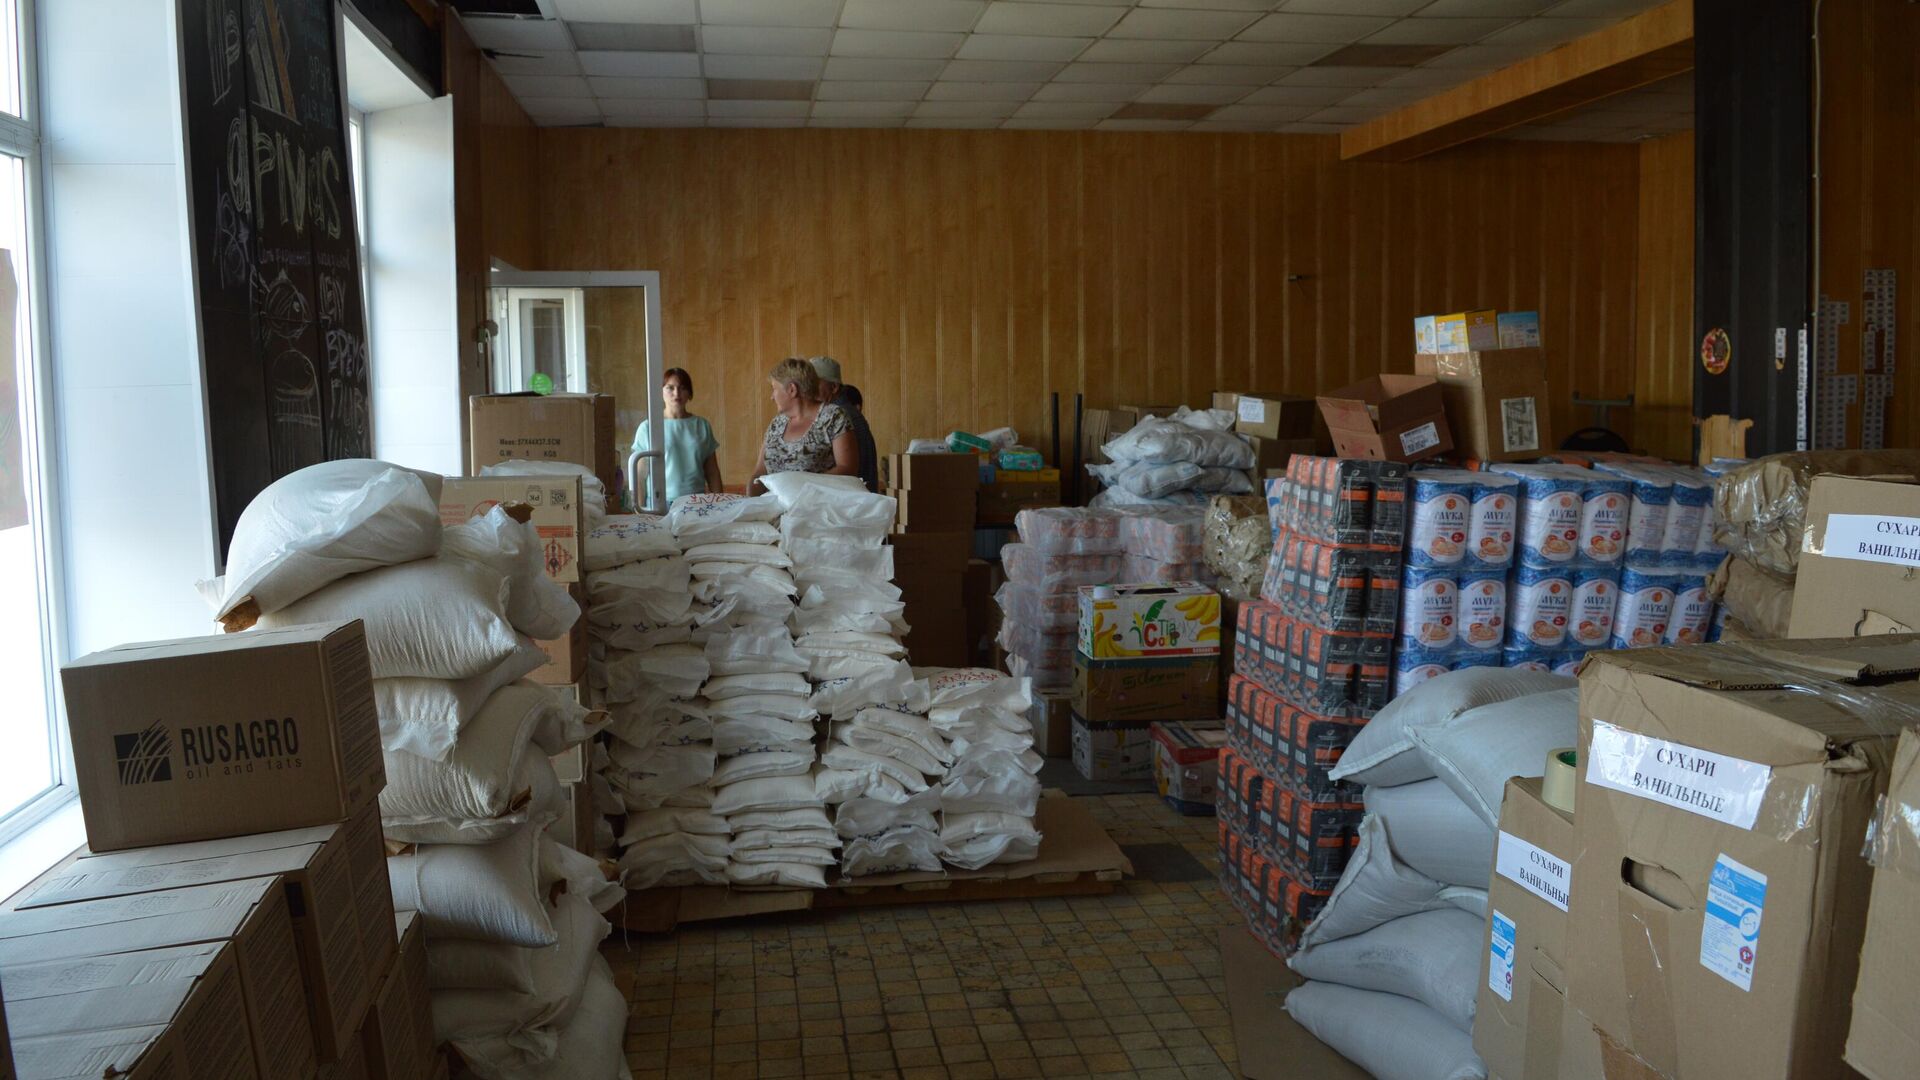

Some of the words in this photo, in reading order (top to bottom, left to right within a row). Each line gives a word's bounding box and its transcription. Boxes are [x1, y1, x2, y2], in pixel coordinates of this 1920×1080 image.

[1877, 521, 1920, 537] СУХАР
[1859, 542, 1920, 560] ВАНИЛЬН
[181, 716, 299, 767] RUSAGRO
[186, 768, 211, 780] oil
[223, 761, 254, 777] and
[267, 757, 303, 771] fats
[1656, 746, 1717, 778] СУХАРИ
[1633, 771, 1726, 814] ВАНИЛЬНЫЕ
[1531, 850, 1564, 879] СУХАРИ
